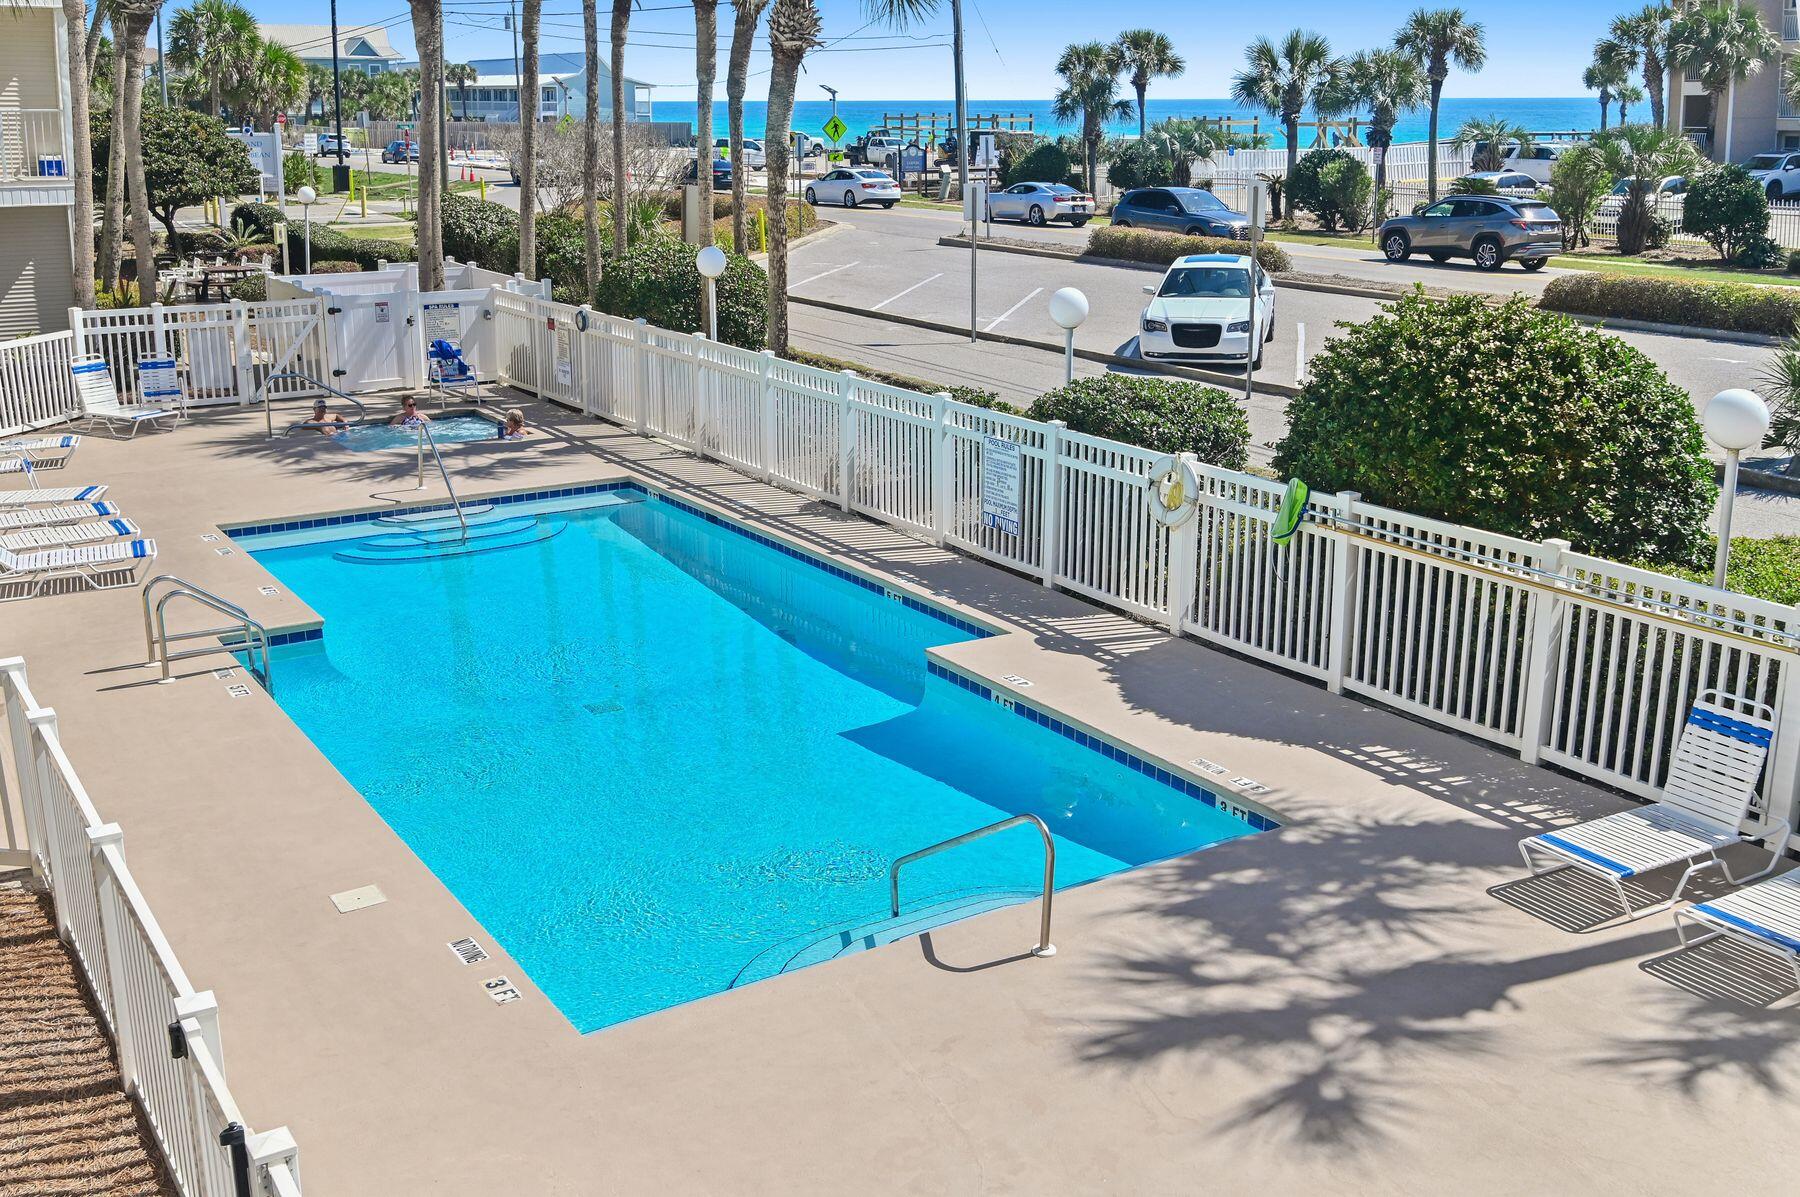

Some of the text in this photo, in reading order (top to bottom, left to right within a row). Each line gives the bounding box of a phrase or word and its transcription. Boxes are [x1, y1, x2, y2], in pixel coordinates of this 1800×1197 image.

[989, 439, 1015, 452] POOL RULES
[1001, 509, 1010, 517] FEET
[983, 512, 1018, 535] NO DIVING
[1003, 698, 1014, 711] FT
[1232, 806, 1247, 821] FT
[485, 979, 521, 1002] 3 FT
